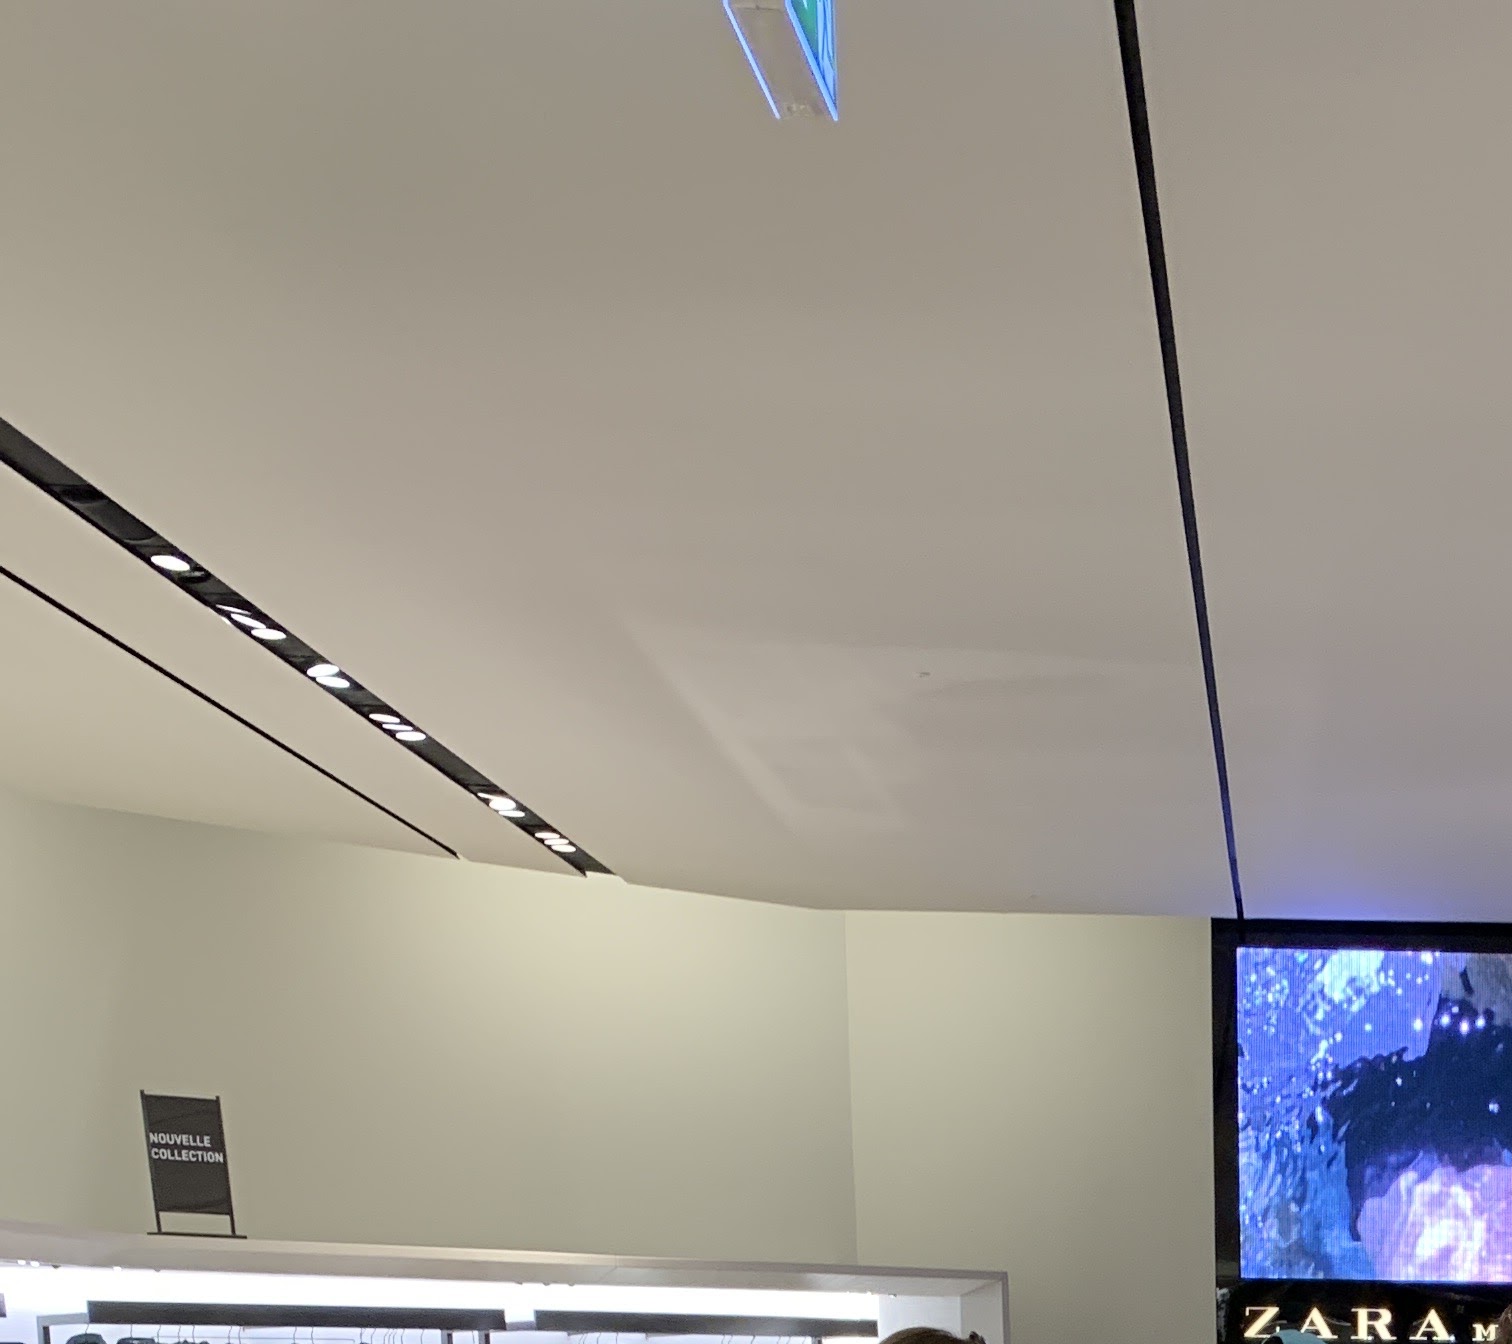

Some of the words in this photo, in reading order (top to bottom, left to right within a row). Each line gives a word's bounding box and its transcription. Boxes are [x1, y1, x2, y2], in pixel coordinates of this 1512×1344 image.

[150, 1131, 211, 1147] NOUVELLE
[151, 1147, 224, 1164] COLLECTION
[1243, 1306, 1456, 1342] ZARA
